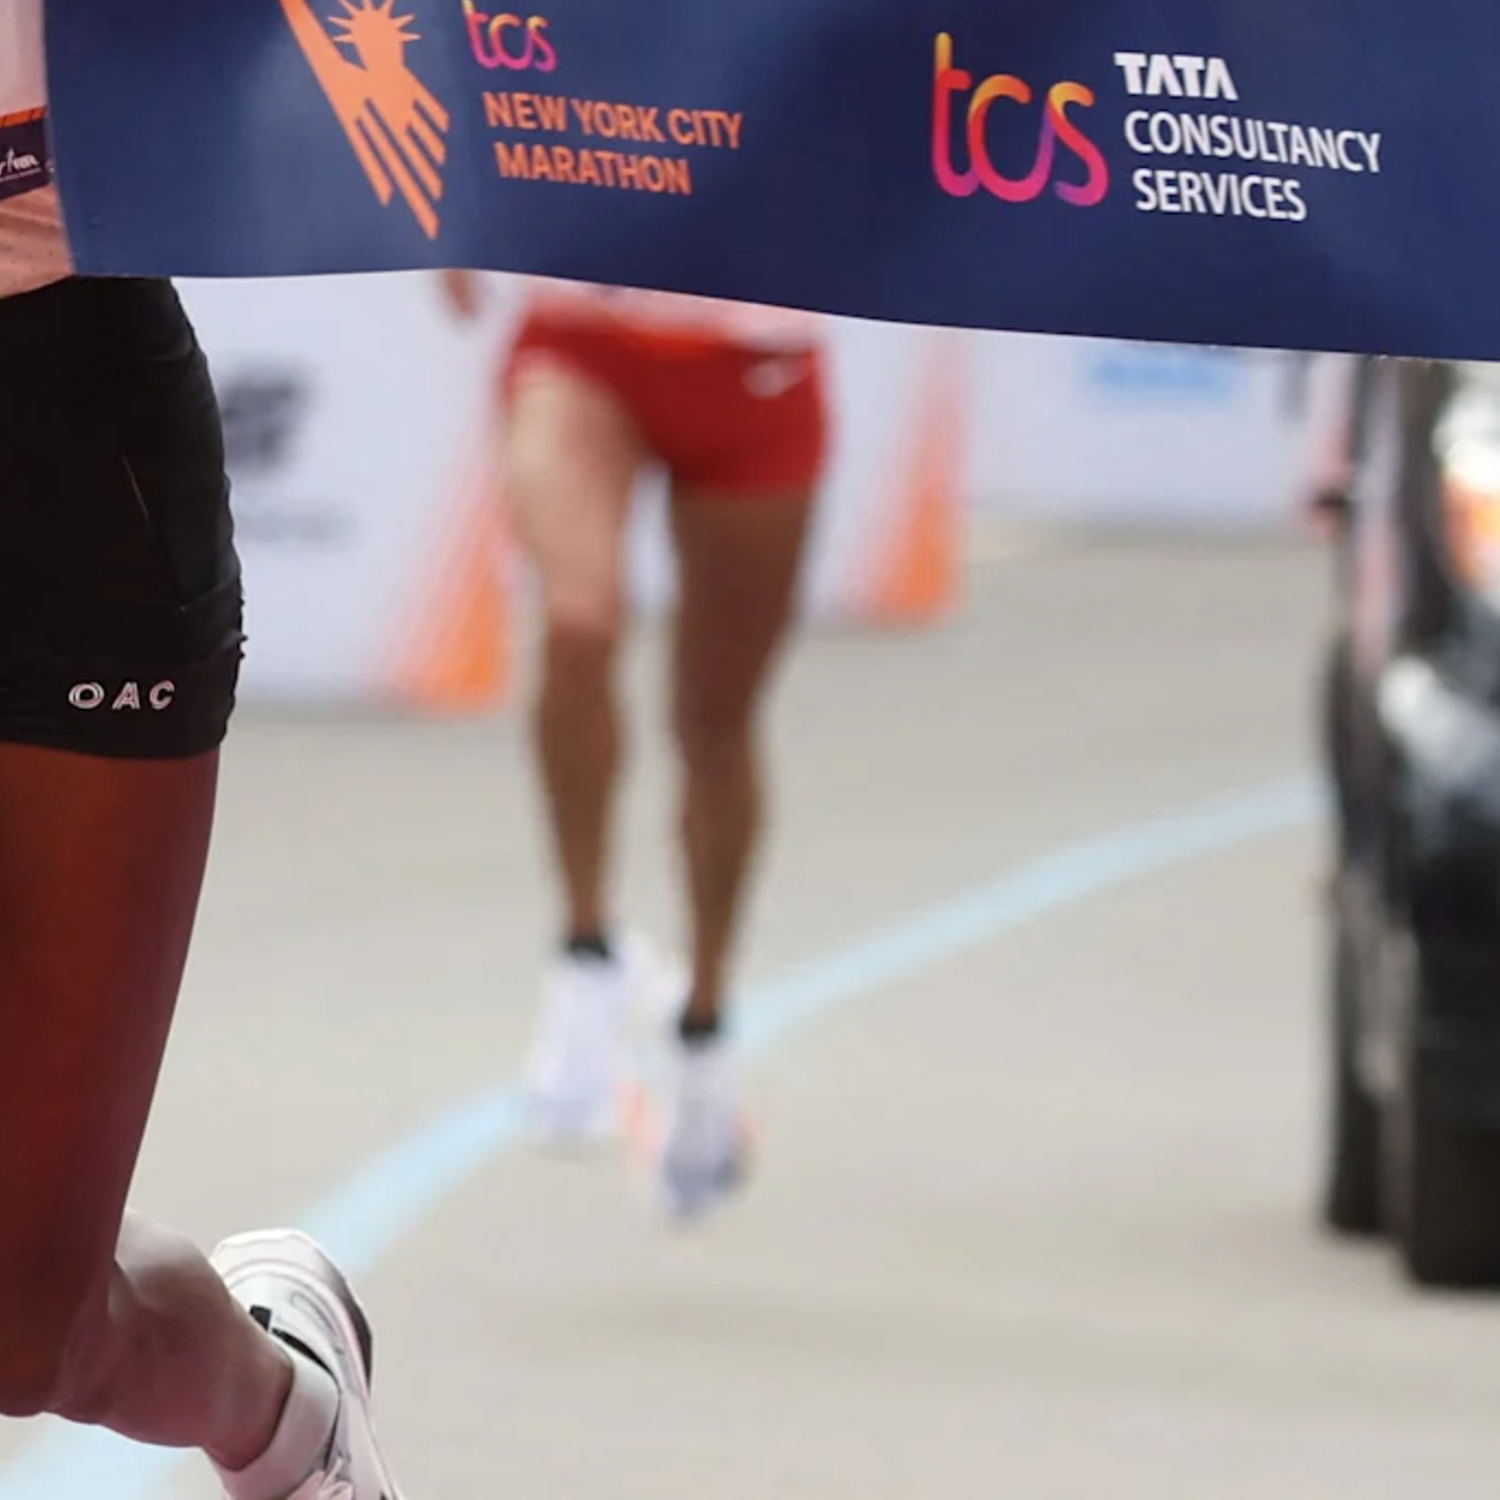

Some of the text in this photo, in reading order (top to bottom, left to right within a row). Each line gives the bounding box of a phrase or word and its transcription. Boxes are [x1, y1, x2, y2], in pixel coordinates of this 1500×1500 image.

[1114, 52, 1238, 100] TATA
[482, 91, 742, 149] NEW YORK CITY
[932, 32, 1109, 207] tcs
[1124, 110, 1382, 173] CONSULTANCY
[494, 142, 692, 194] MARATHON
[1132, 168, 1307, 221] SERVICES
[68, 679, 175, 710] OAC
